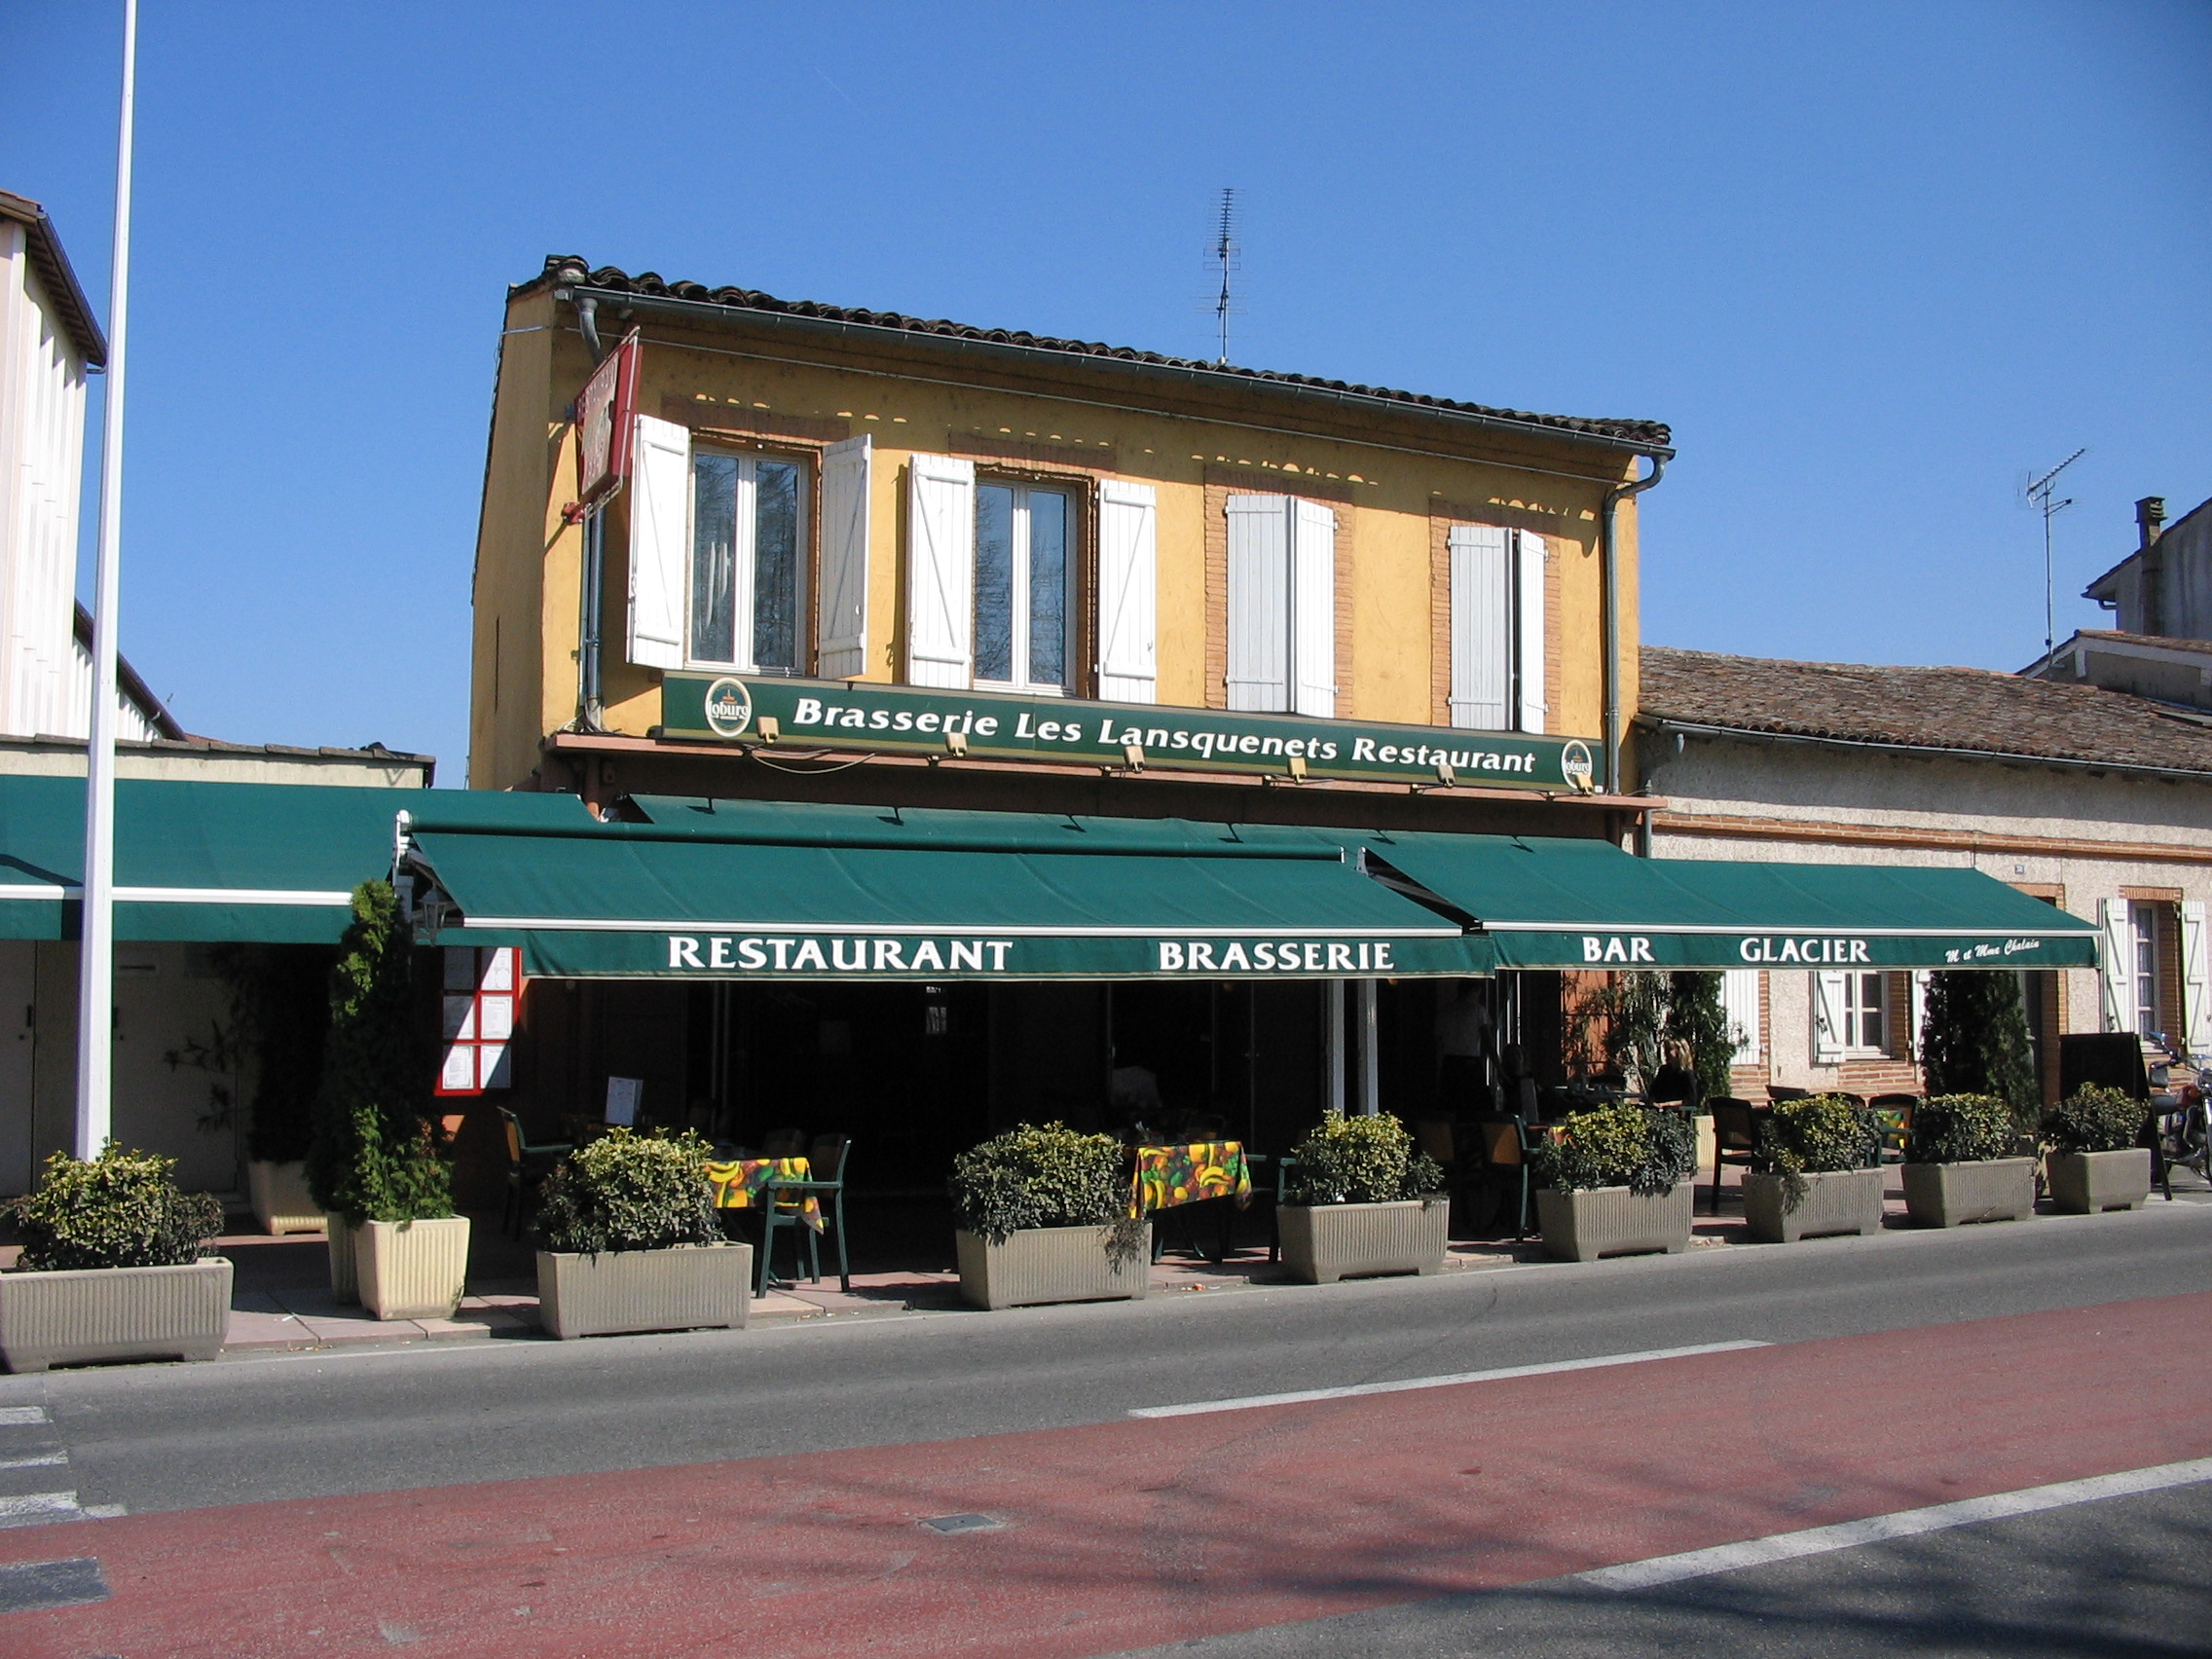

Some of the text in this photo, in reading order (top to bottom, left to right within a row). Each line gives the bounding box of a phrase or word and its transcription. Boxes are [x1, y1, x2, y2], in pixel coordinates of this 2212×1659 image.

[793, 698, 1536, 773] Brasserie Les Lansquenets Restaurant
[668, 936, 1014, 972] RESTAURANT
[1159, 941, 1394, 971] BRASSERIE
[1581, 936, 1656, 962] BAR
[1739, 937, 1871, 963] GLACIER
[1945, 949, 1960, 963] M
[1963, 949, 1972, 961] et
[1974, 944, 2000, 957] Mme
